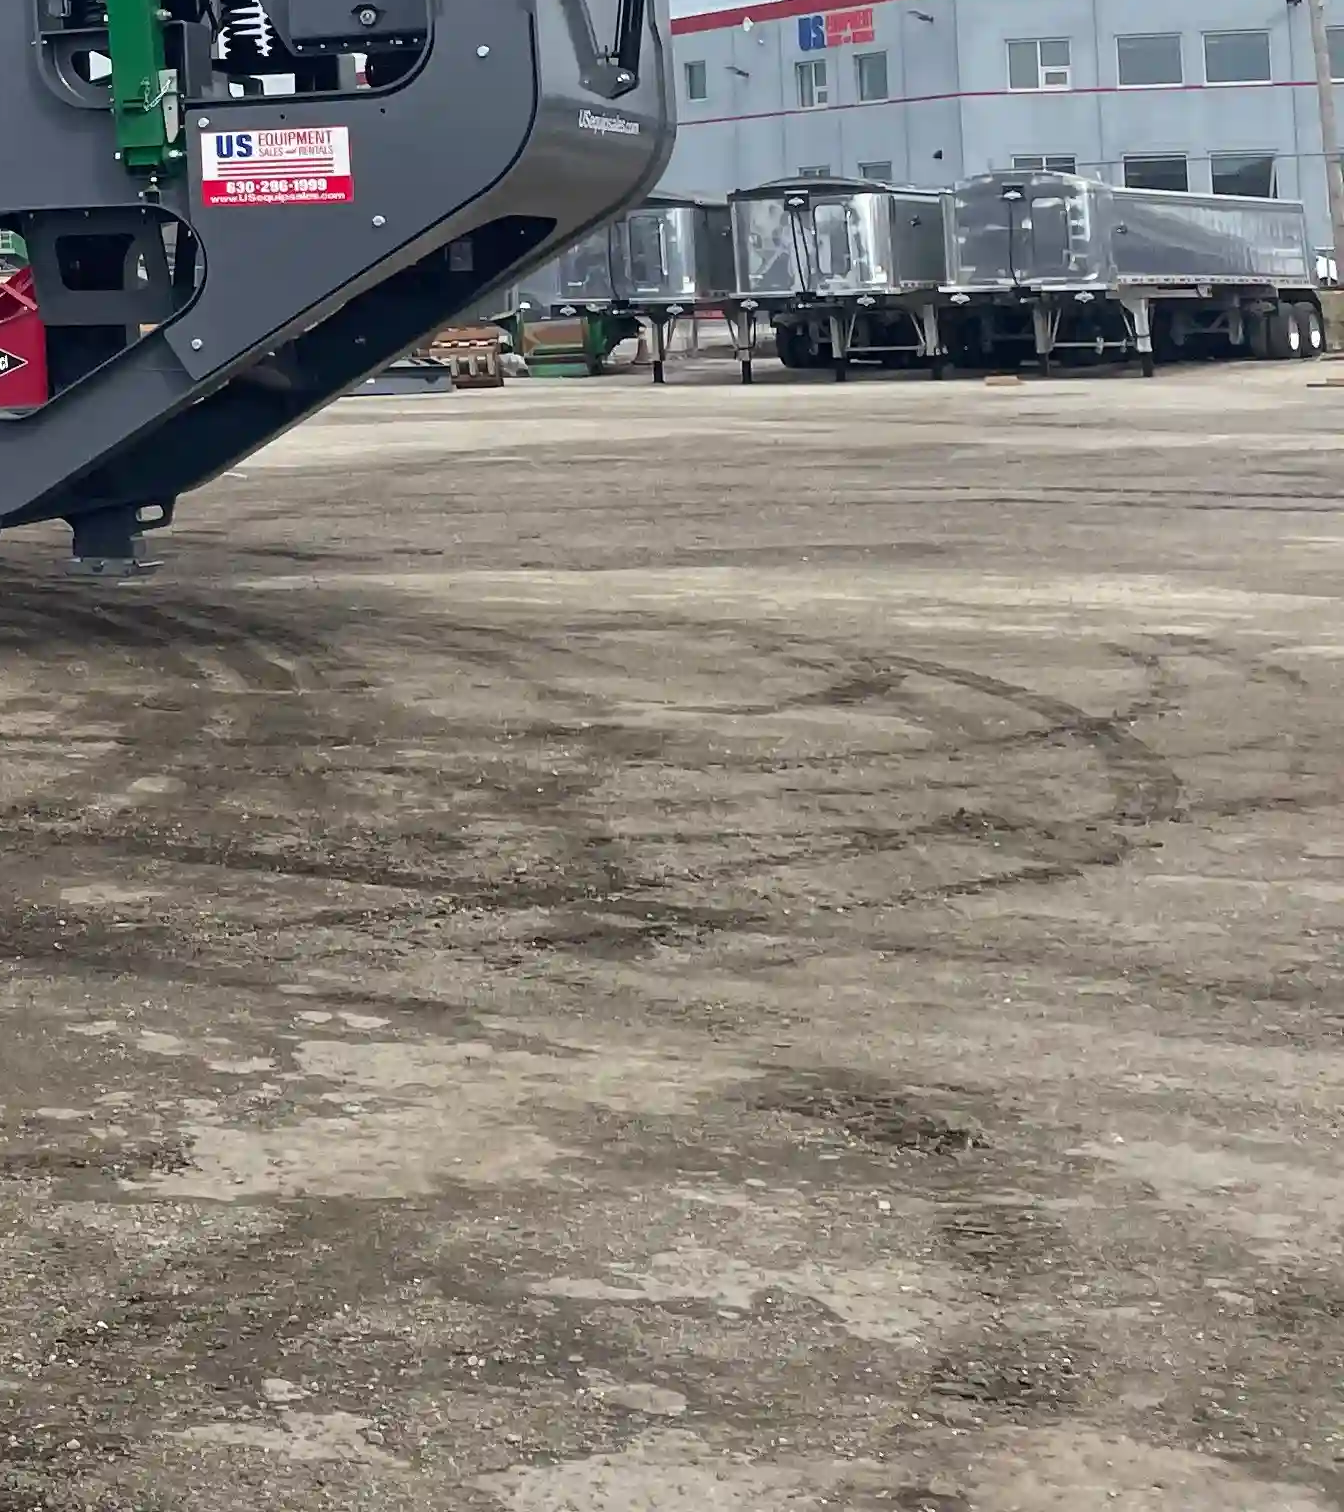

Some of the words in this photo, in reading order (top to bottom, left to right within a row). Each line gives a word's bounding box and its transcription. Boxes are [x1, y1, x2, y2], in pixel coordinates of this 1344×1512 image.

[799, 15, 826, 51] US
[216, 134, 253, 158] US
[258, 130, 333, 147] EQUIPMENT
[258, 146, 284, 157] SALES
[298, 145, 334, 156] RENTALS
